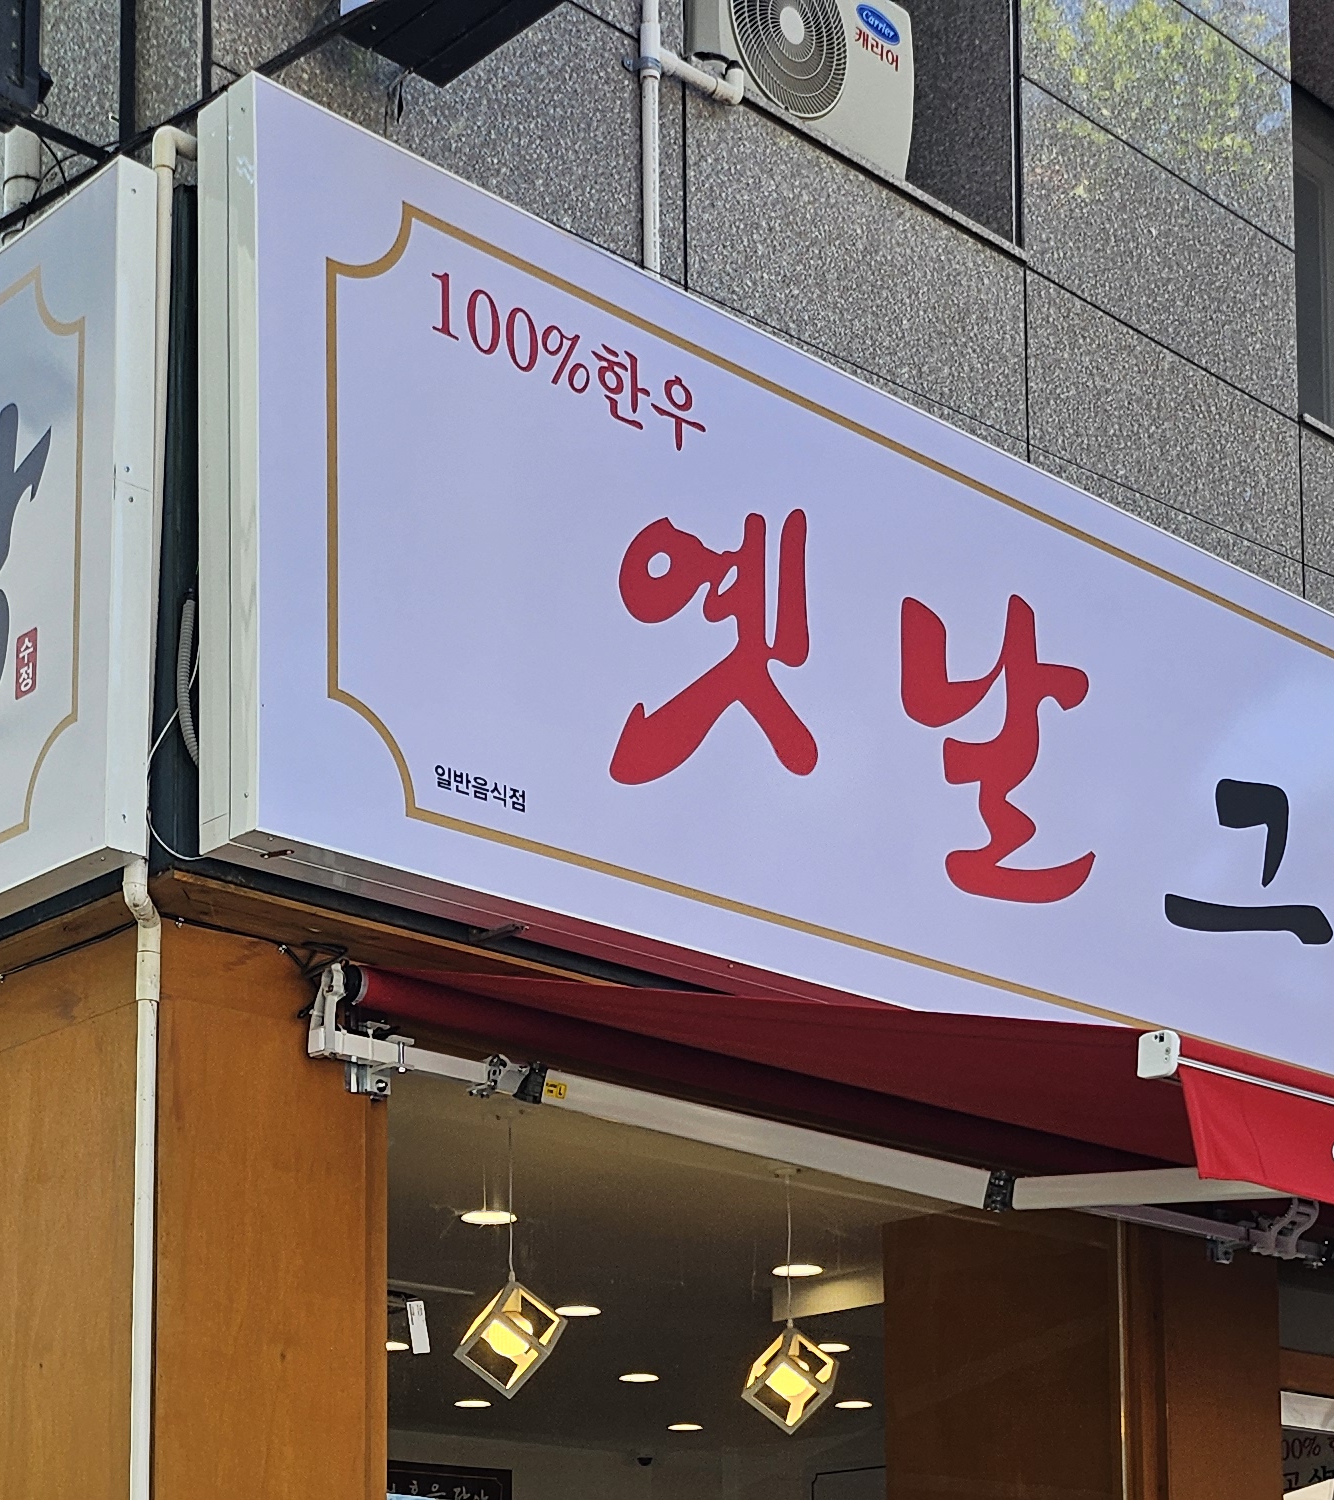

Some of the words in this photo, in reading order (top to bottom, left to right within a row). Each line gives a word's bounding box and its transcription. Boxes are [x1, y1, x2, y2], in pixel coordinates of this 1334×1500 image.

[854, 26, 899, 72] 캐리어
[862, 10, 895, 38] Carrier
[430, 271, 707, 451] 100%한우
[16, 635, 37, 694] 수정
[609, 508, 1097, 904] 옛날
[1164, 778, 1334, 945] 그
[433, 764, 528, 813] 일반음식점
